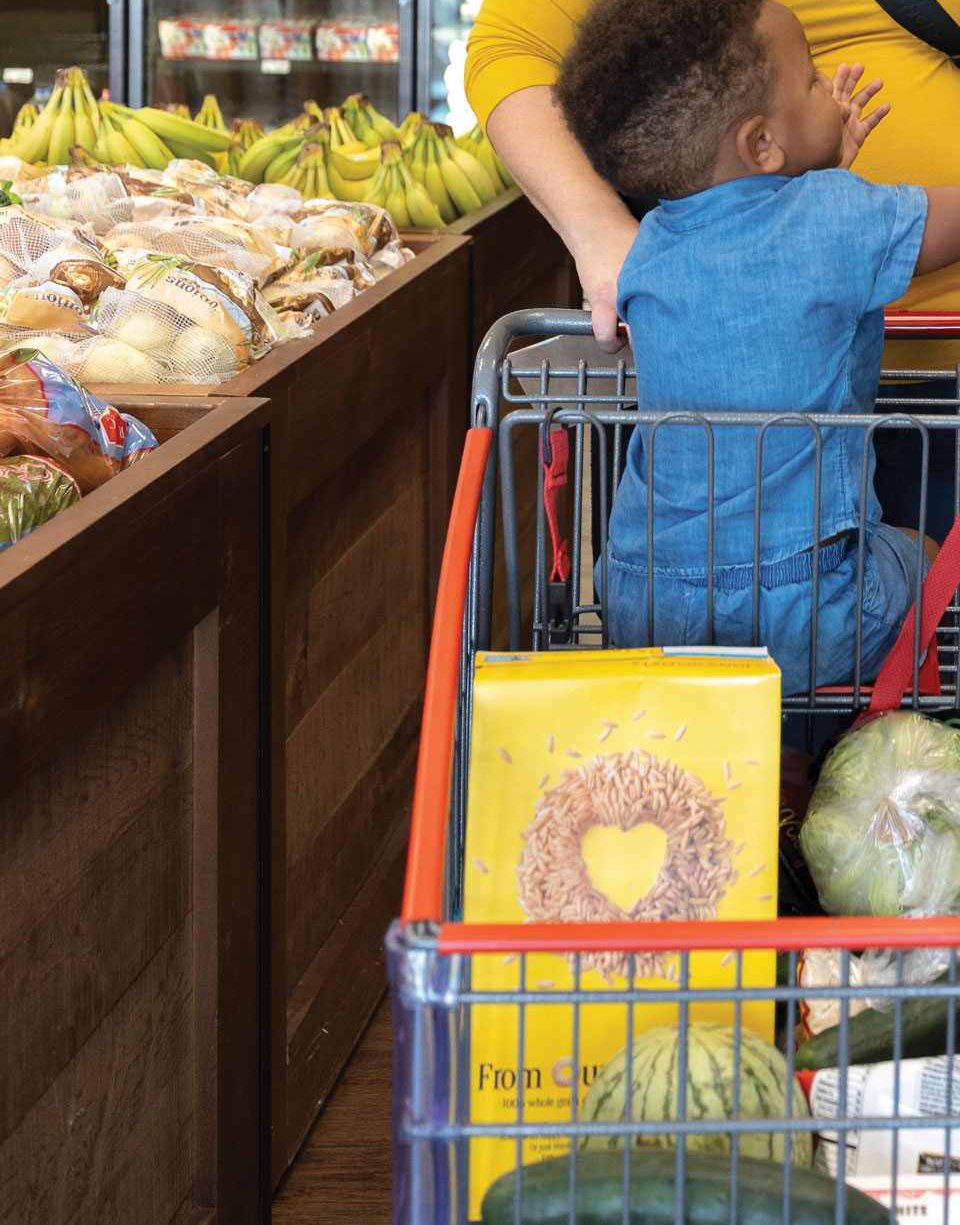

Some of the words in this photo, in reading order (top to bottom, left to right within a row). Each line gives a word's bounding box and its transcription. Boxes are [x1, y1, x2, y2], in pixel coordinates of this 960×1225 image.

[478, 1063, 542, 1090] From
[551, 1056, 603, 1088] Ou
[528, 1097, 554, 1108] whole
